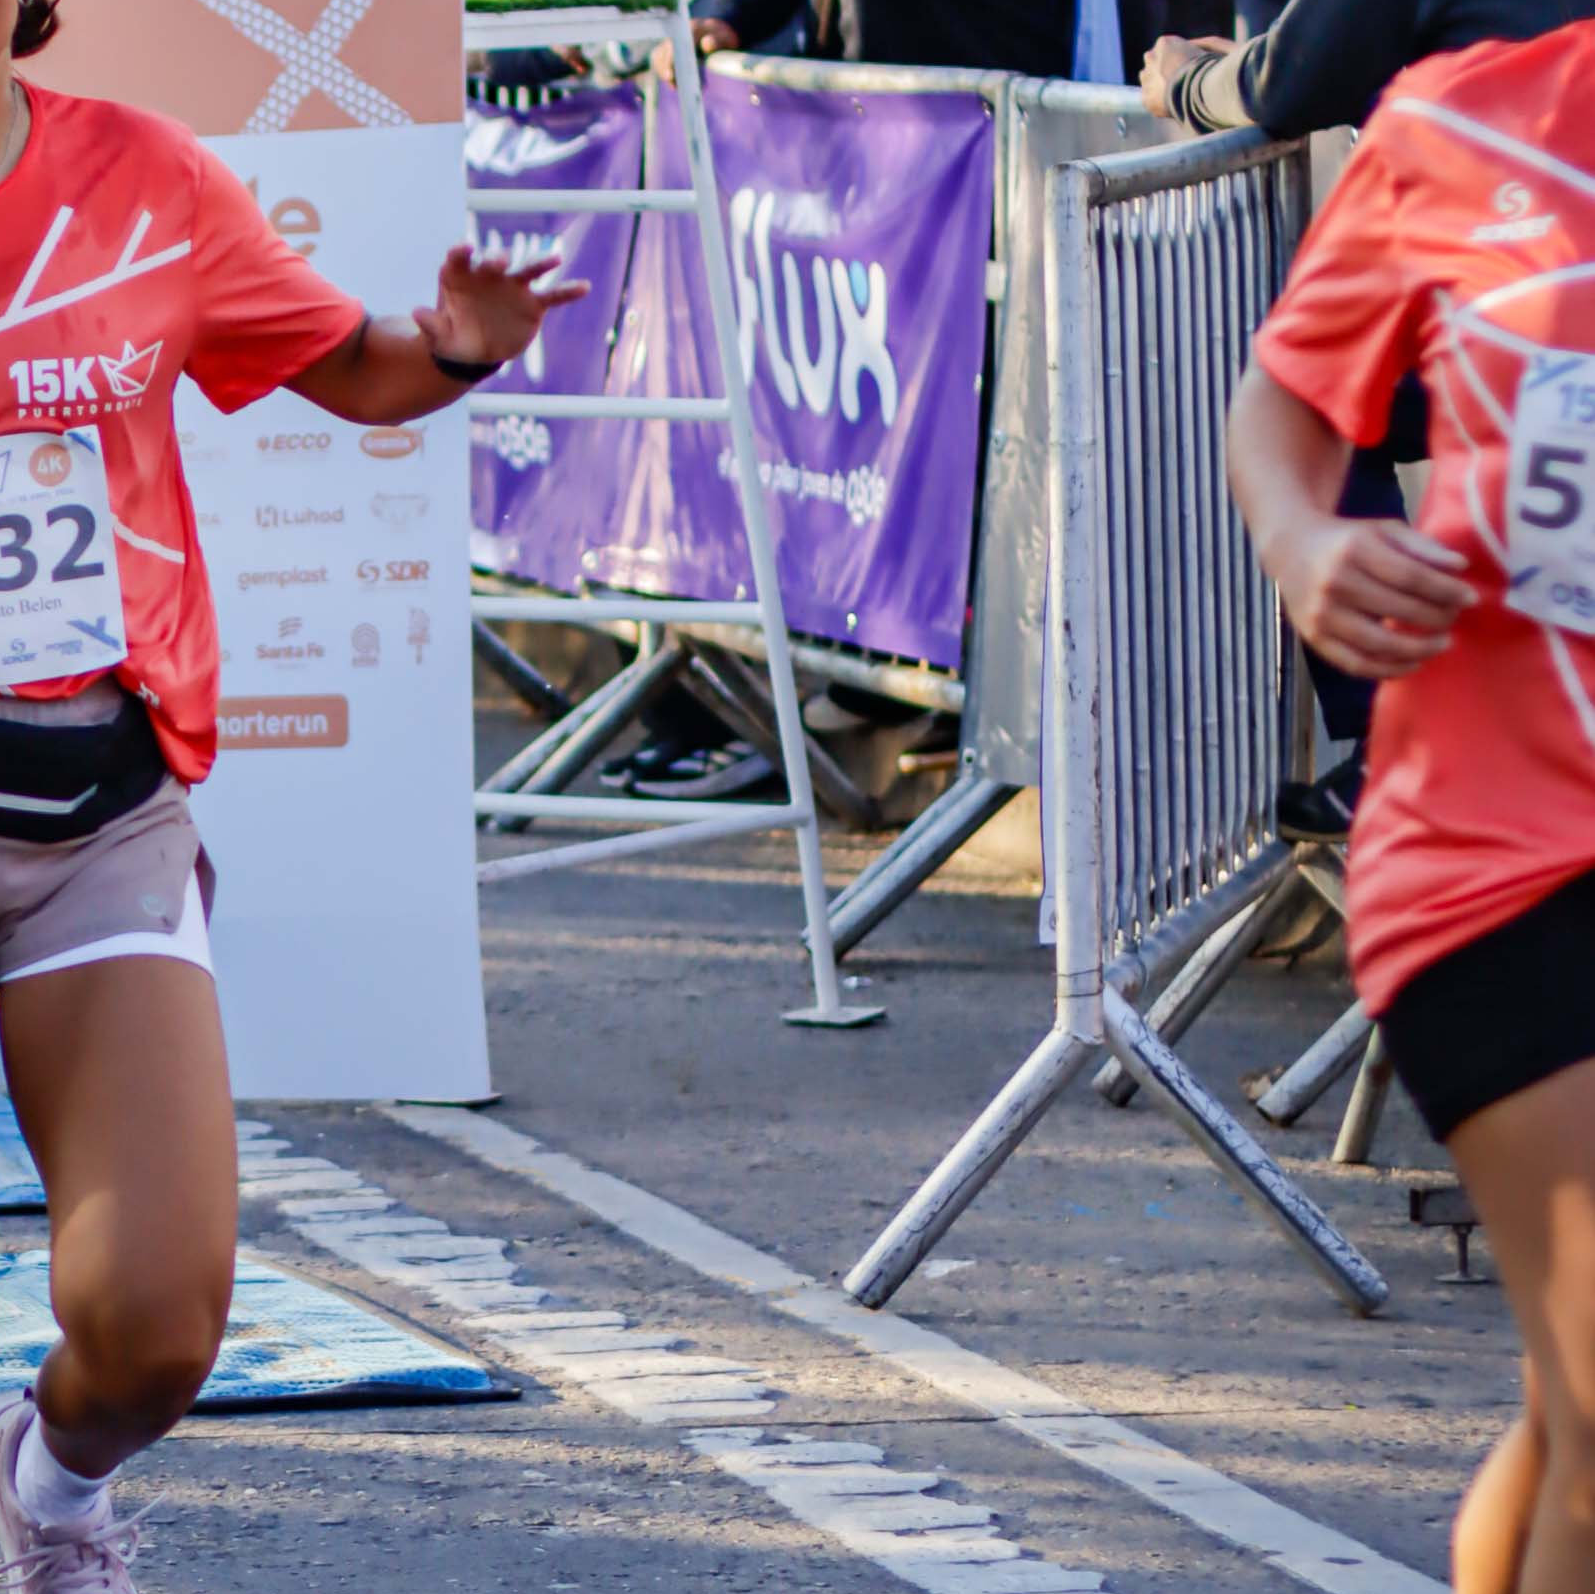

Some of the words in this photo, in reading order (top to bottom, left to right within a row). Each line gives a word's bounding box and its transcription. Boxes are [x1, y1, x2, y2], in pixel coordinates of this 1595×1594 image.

[730, 188, 898, 429] FLUX
[9, 356, 98, 405] 15K
[18, 404, 98, 419] PUERTO
[272, 432, 332, 451] ECCO
[36, 454, 63, 473] 4K
[846, 464, 887, 527] osde
[238, 566, 329, 592] gemplast
[385, 560, 430, 582] SDR
[256, 644, 304, 660] Santa
[307, 643, 324, 658] Fe
